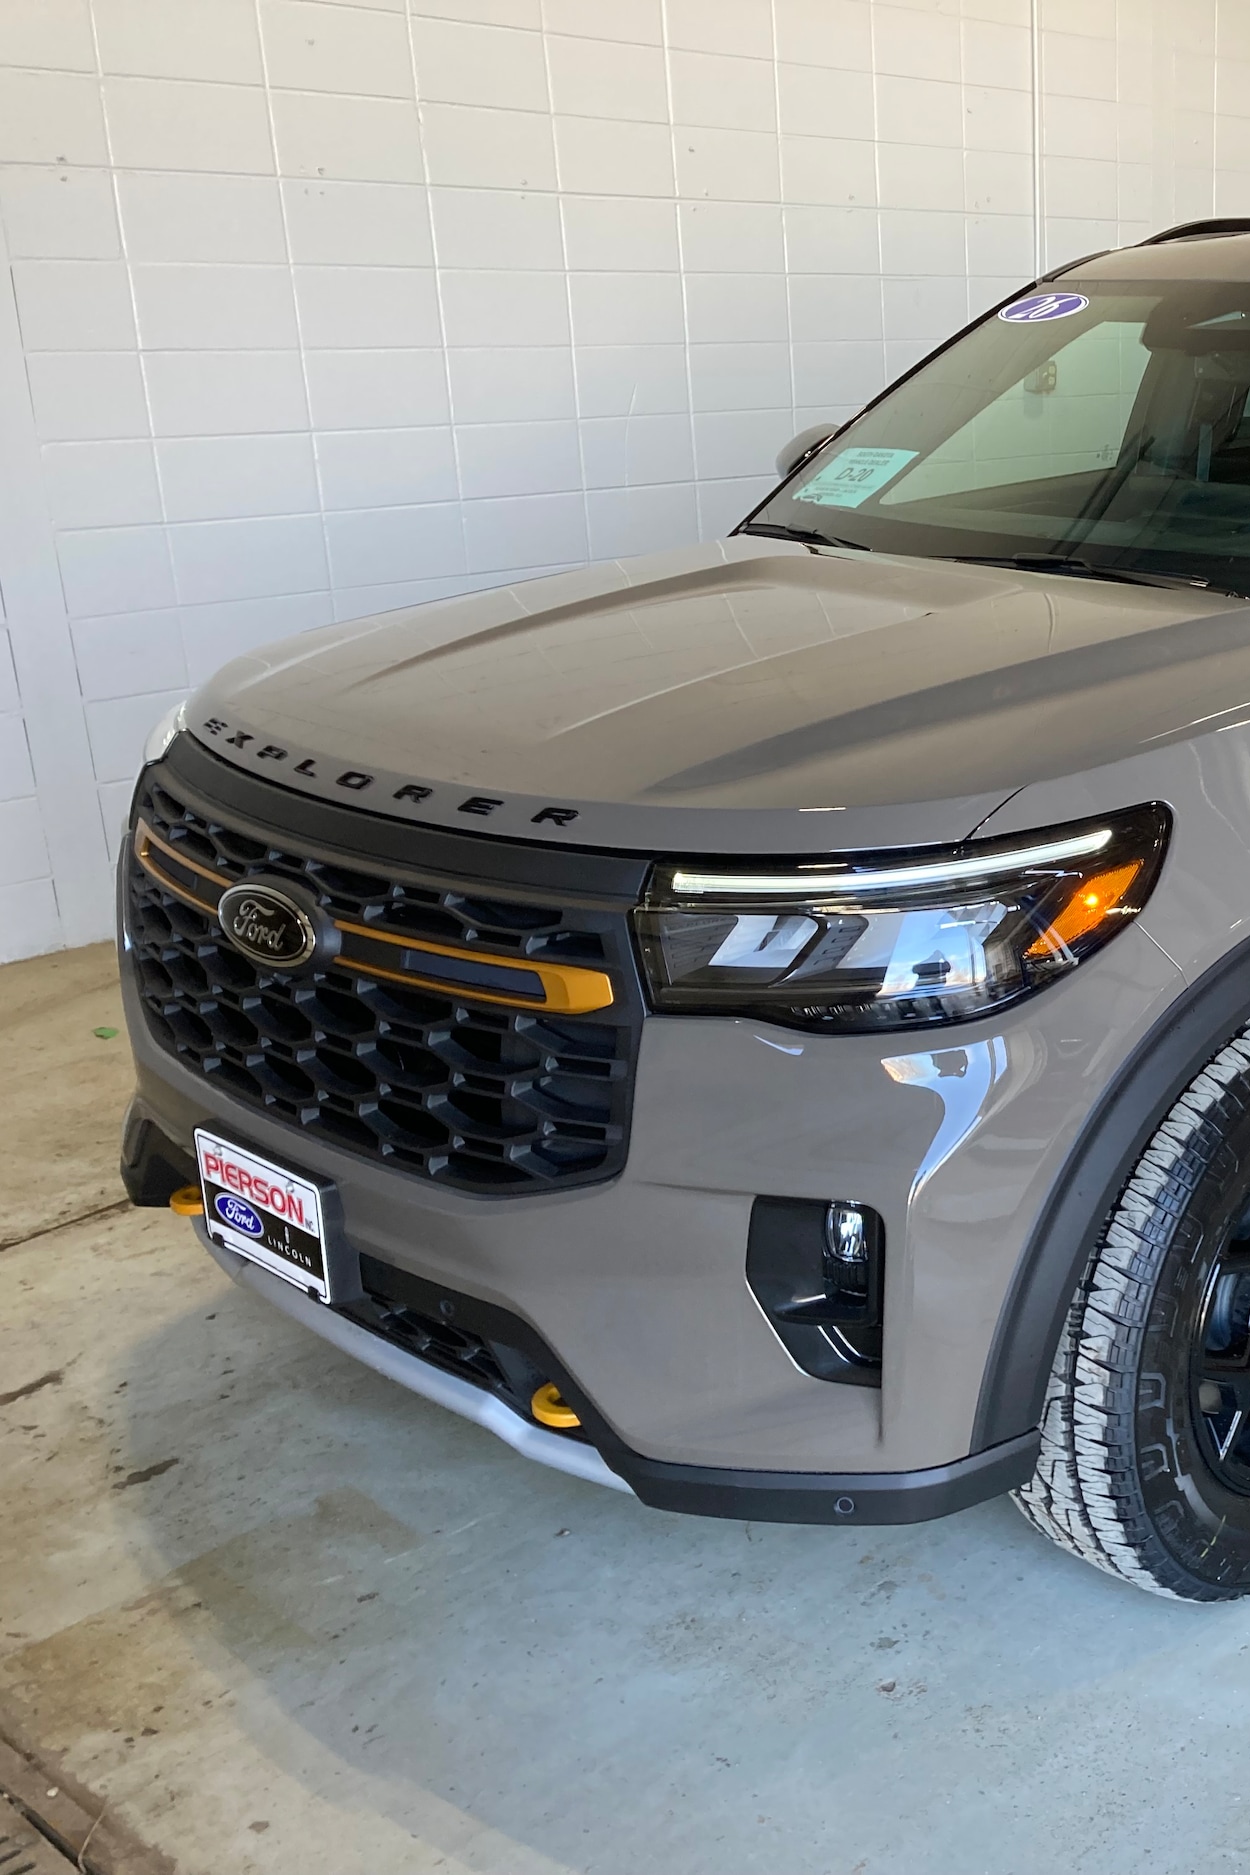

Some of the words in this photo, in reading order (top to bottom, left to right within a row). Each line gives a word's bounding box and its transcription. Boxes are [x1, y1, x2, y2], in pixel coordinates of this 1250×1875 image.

[1007, 296, 1078, 319] 26
[834, 467, 875, 482] D-20
[203, 717, 580, 827] EXPLORER
[232, 899, 286, 951] Ford
[203, 1151, 305, 1226] PIERSON
[224, 1199, 255, 1230] Ford
[266, 1234, 312, 1268] LINCOLN
